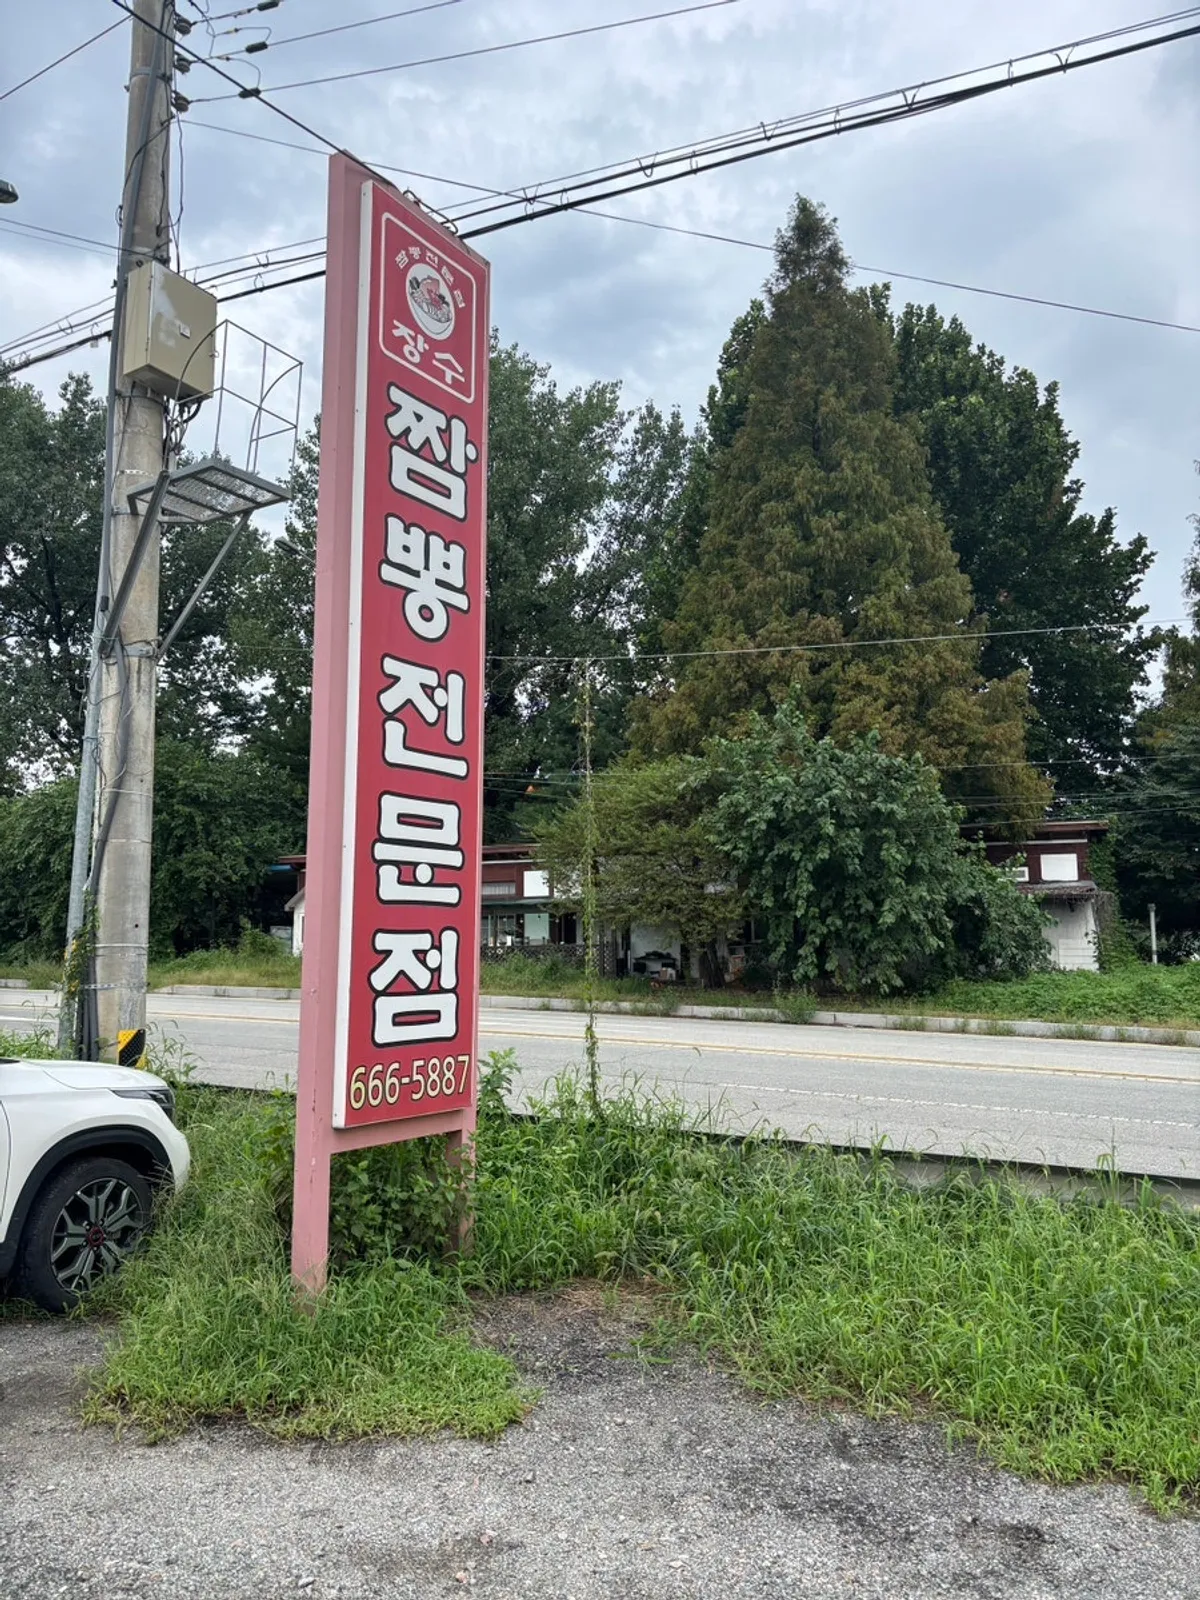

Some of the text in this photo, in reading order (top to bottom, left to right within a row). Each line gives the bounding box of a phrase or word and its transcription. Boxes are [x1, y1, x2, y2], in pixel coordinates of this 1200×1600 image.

[392, 319, 465, 384] 장수
[368, 382, 479, 1047] 짬뽕전문점
[349, 1054, 470, 1110] 666-5887
